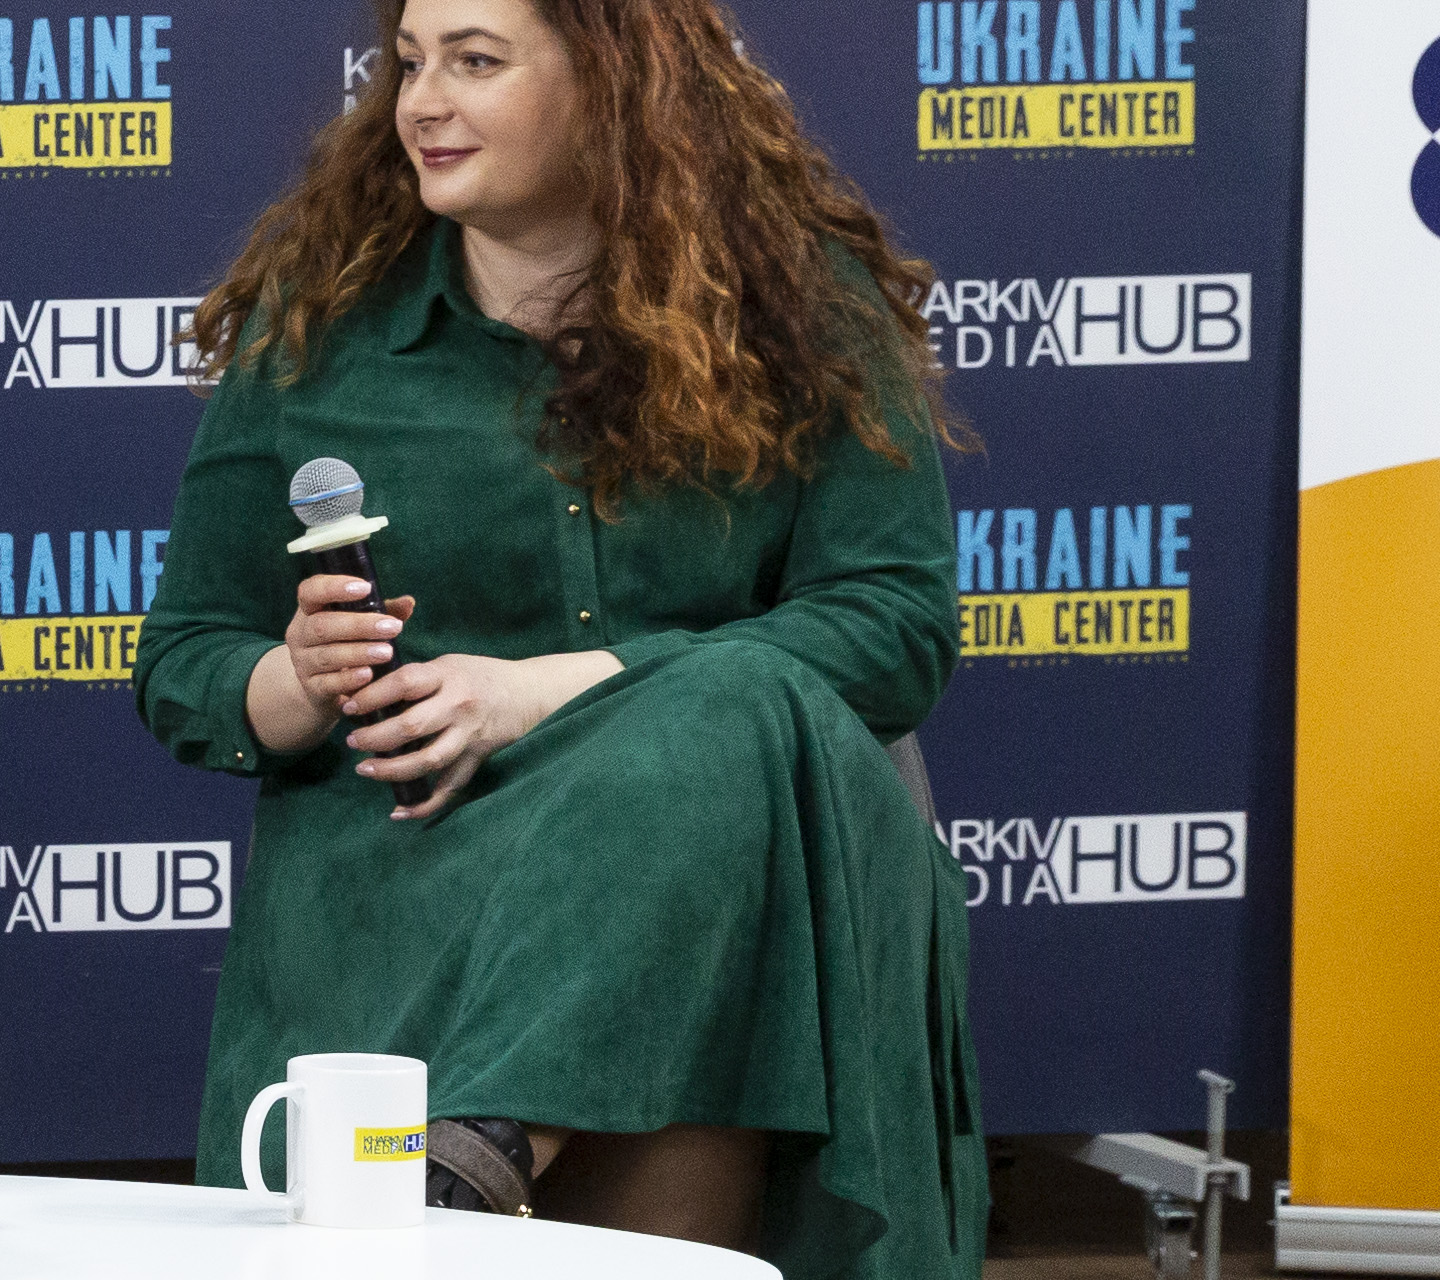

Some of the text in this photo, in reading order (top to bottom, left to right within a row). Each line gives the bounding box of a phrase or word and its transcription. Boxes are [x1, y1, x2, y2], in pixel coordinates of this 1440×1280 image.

[34, 111, 157, 157] CENTER
[931, 91, 1180, 140] MEDIA CENTER
[919, 278, 1064, 323] ARKIV
[1075, 283, 1242, 356] HUB
[958, 505, 1190, 591] KRAINE
[960, 598, 1174, 647] EDIA CENTER
[34, 625, 137, 670] CENTE
[935, 818, 1060, 861] RKIV
[1070, 821, 1237, 894] HUB
[52, 850, 222, 923] HUB
